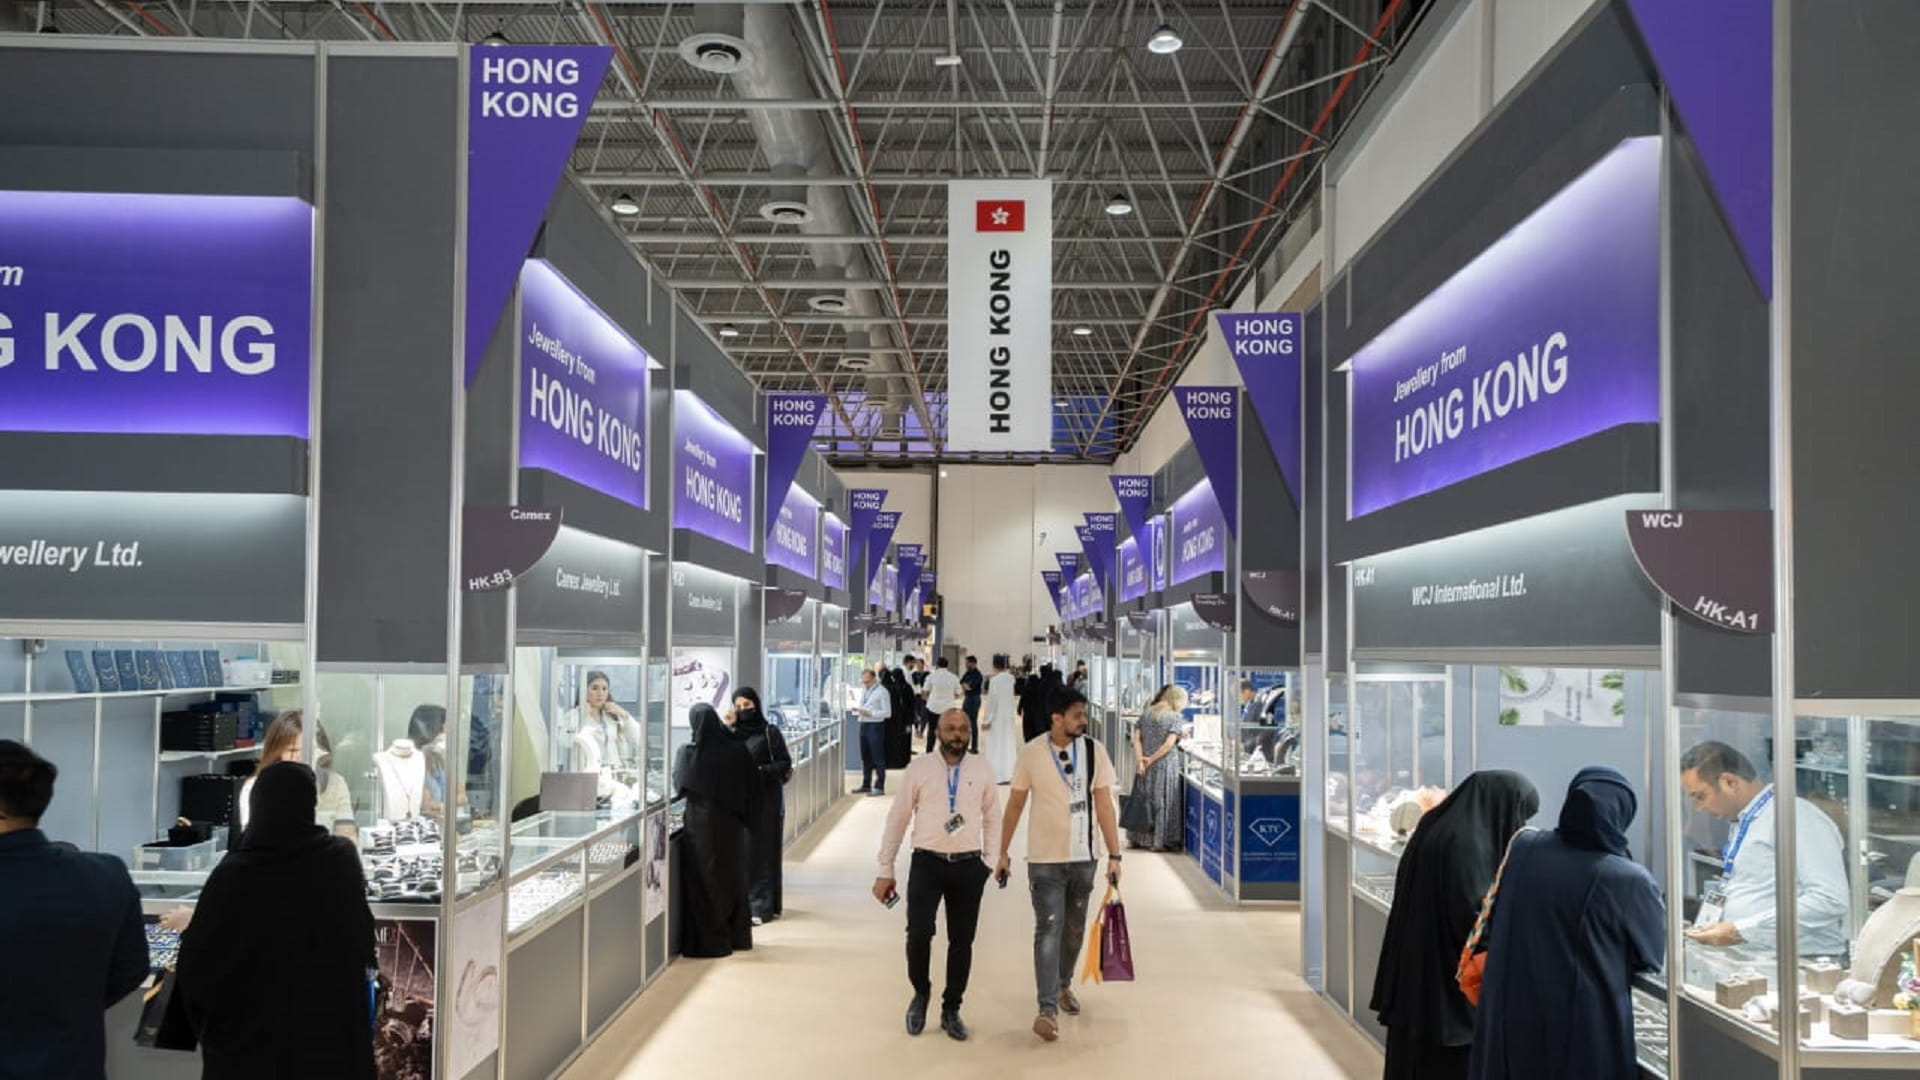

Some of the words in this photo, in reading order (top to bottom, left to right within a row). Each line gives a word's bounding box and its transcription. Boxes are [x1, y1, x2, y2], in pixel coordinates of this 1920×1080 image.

[483, 57, 579, 85] HONG
[482, 91, 579, 118] KONG
[989, 249, 1011, 335] KONG
[1235, 320, 1293, 335] HONG
[44, 312, 276, 375] KONG
[529, 322, 576, 375] Jewellery
[576, 354, 597, 385] from
[1235, 339, 1293, 354] KONG
[1393, 361, 1439, 402] Jewellery
[1441, 344, 1467, 375] from
[989, 346, 1011, 433] HONG
[1186, 392, 1232, 405] HONG
[1394, 387, 1464, 463] HONG
[1471, 331, 1568, 429] KONG
[773, 400, 816, 412] HONG
[1186, 406, 1232, 419] KONG
[530, 367, 594, 445] HONG
[598, 408, 641, 472] KONG
[773, 413, 816, 426] KONG
[685, 464, 715, 511] HONG
[716, 483, 742, 523] KONG
[1118, 478, 1149, 488] HONG
[1118, 488, 1149, 498] KONG
[853, 492, 880, 501] HONG
[853, 501, 880, 510] KONG
[510, 508, 552, 521] Camex
[1642, 513, 1683, 528] WCJ
[94, 541, 143, 567] Ltd.
[469, 568, 513, 590] HK-B3
[1412, 584, 1434, 606] WCJ
[1433, 575, 1500, 604] International
[1501, 572, 1526, 598] Ltd.
[1694, 596, 1759, 630] HK-A1
